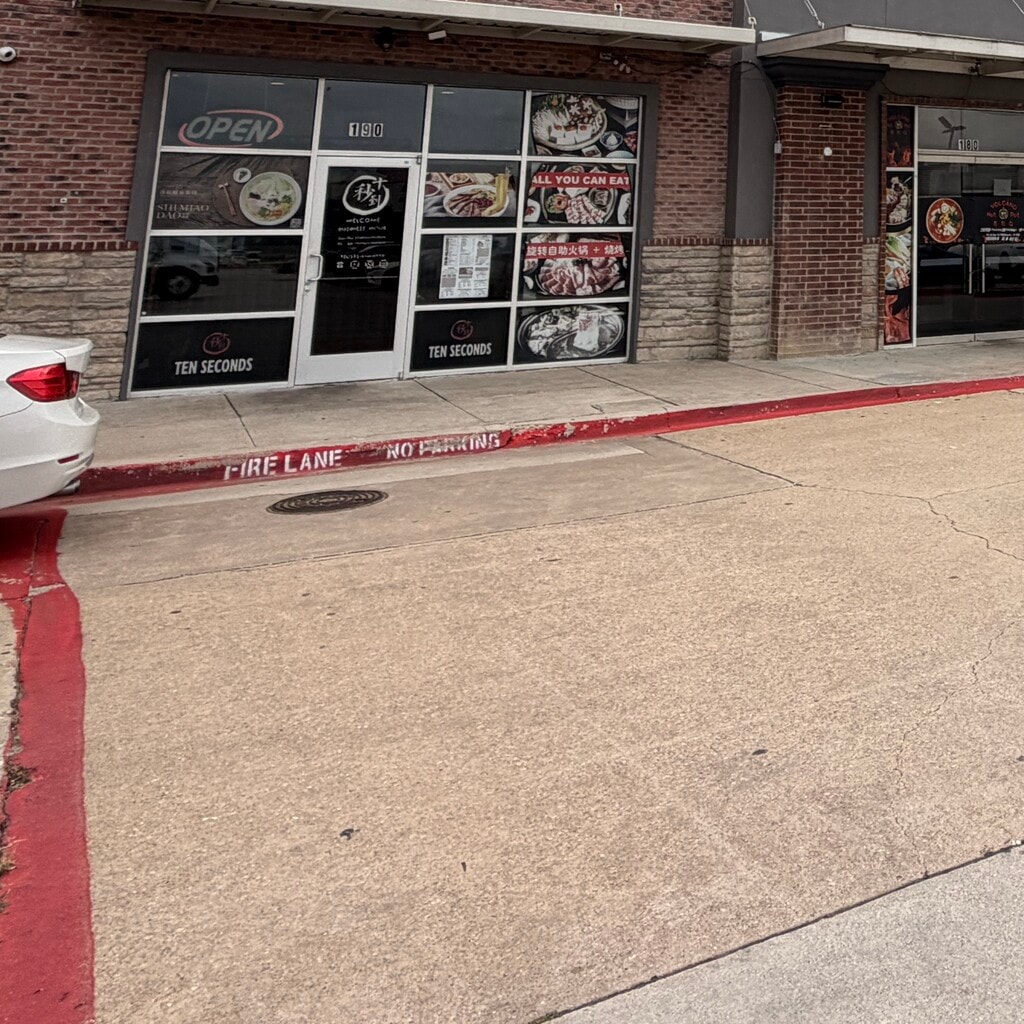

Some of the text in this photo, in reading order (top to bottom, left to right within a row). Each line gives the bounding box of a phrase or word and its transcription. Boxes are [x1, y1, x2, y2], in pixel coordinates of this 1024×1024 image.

[186, 116, 274, 143] OPEN
[348, 123, 384, 138] 190
[958, 139, 980, 151] 180
[531, 175, 629, 186] ALL YOU CAN EAT
[429, 342, 492, 358] TEN SECONDS
[174, 357, 254, 375] TEN SECONDS
[223, 455, 279, 481] FIRE
[284, 449, 342, 474] LANE
[386, 442, 414, 460] NO
